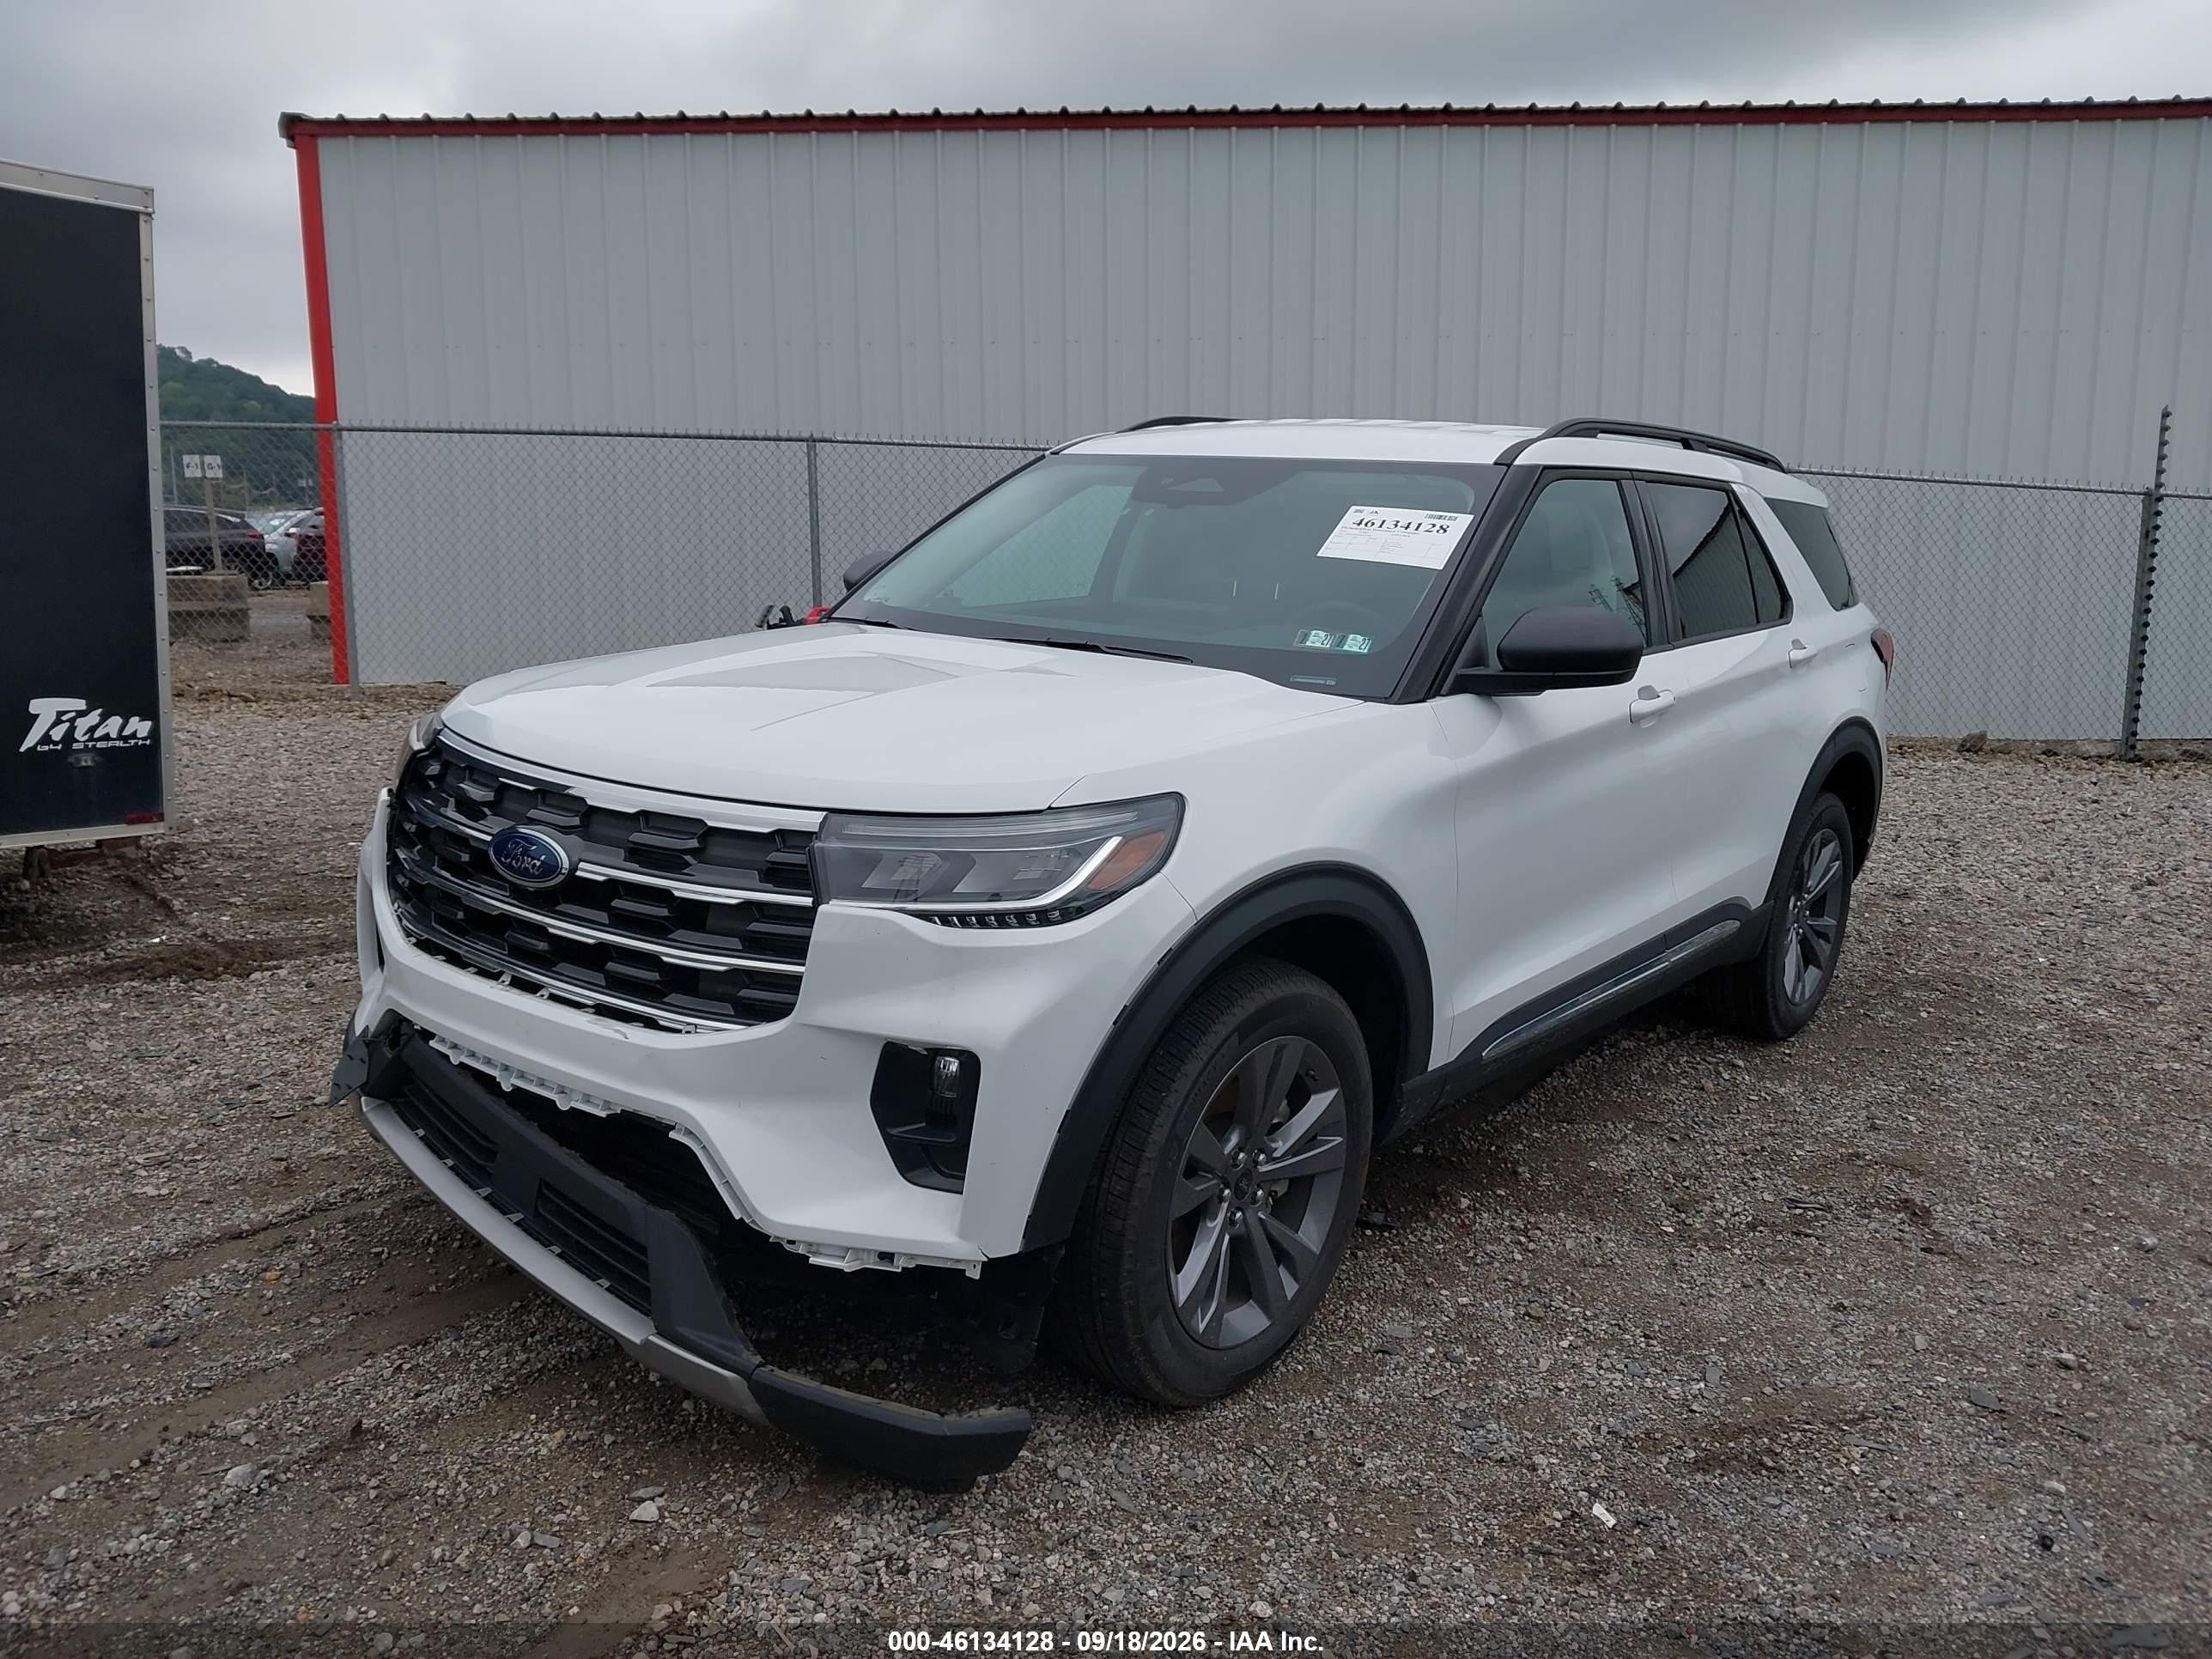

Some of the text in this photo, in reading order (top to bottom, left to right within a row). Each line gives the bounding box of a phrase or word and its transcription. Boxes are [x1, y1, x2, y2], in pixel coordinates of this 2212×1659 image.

[1352, 517, 1450, 535] 46134128
[1320, 634, 1334, 647] 27
[1358, 637, 1371, 652] 27
[18, 697, 153, 752] Titan
[71, 738, 151, 750] STEALTH
[500, 838, 546, 875] Ford
